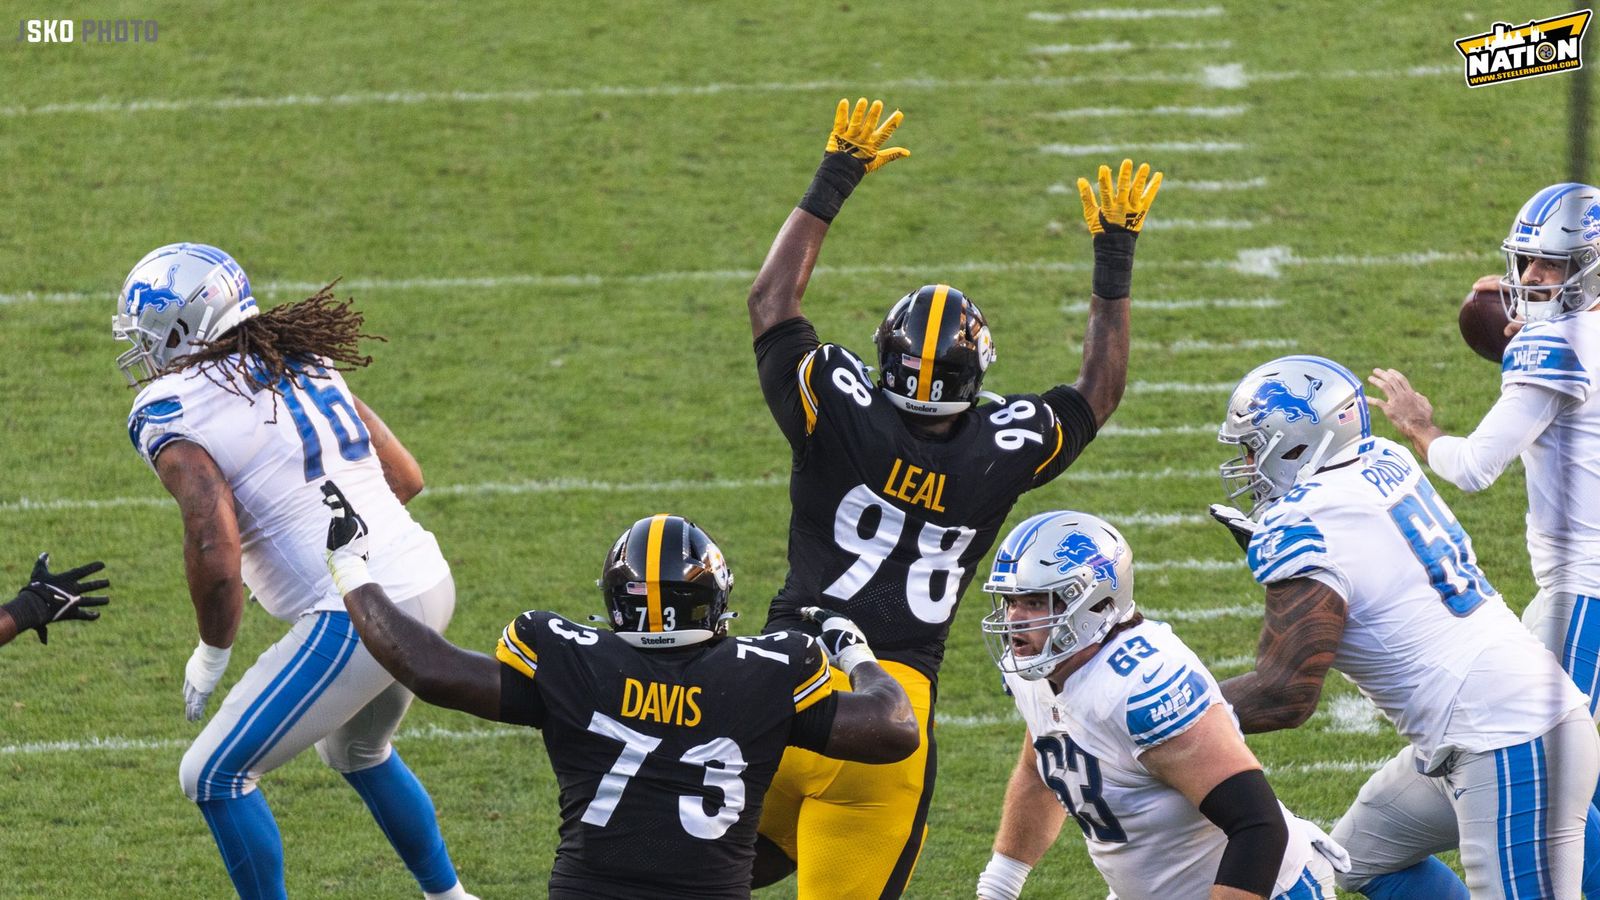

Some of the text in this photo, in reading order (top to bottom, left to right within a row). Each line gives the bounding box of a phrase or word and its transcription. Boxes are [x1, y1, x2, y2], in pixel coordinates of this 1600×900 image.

[1513, 350, 1551, 366] WCF
[905, 402, 938, 413] Steelers
[990, 400, 1043, 450] 98
[883, 457, 947, 513] LEAL
[822, 483, 977, 624] 98
[641, 636, 676, 645] Steelers
[735, 630, 790, 666] 73
[1107, 635, 1159, 677] 63
[620, 677, 703, 728] DAVIS
[1149, 682, 1193, 724] WCF
[580, 710, 749, 840] 73
[1033, 733, 1129, 844] 63
